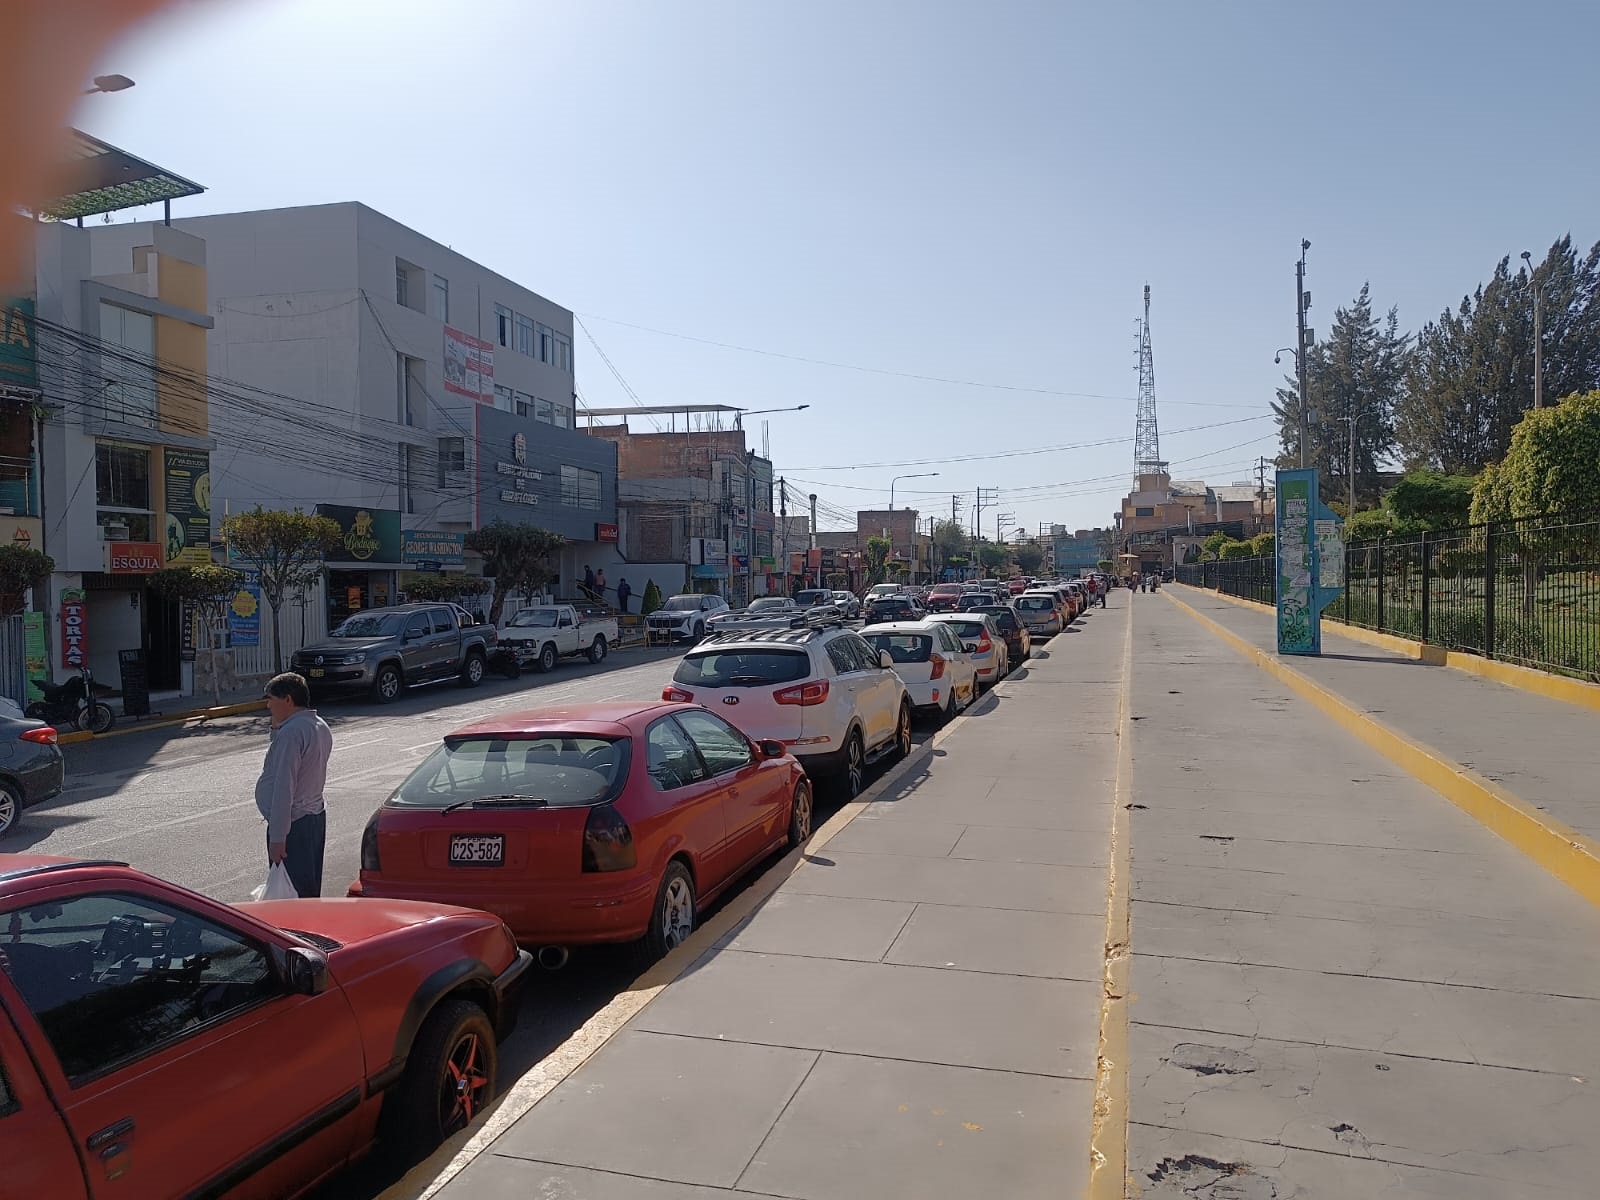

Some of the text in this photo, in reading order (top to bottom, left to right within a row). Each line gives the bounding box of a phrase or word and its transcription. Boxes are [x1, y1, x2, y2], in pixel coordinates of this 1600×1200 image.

[406, 541, 429, 554] GEORGE
[429, 542, 463, 555] WASHINGTON
[112, 557, 160, 569] ESQUIA
[65, 605, 83, 665] TORTAS
[452, 842, 501, 860] C2S-582
